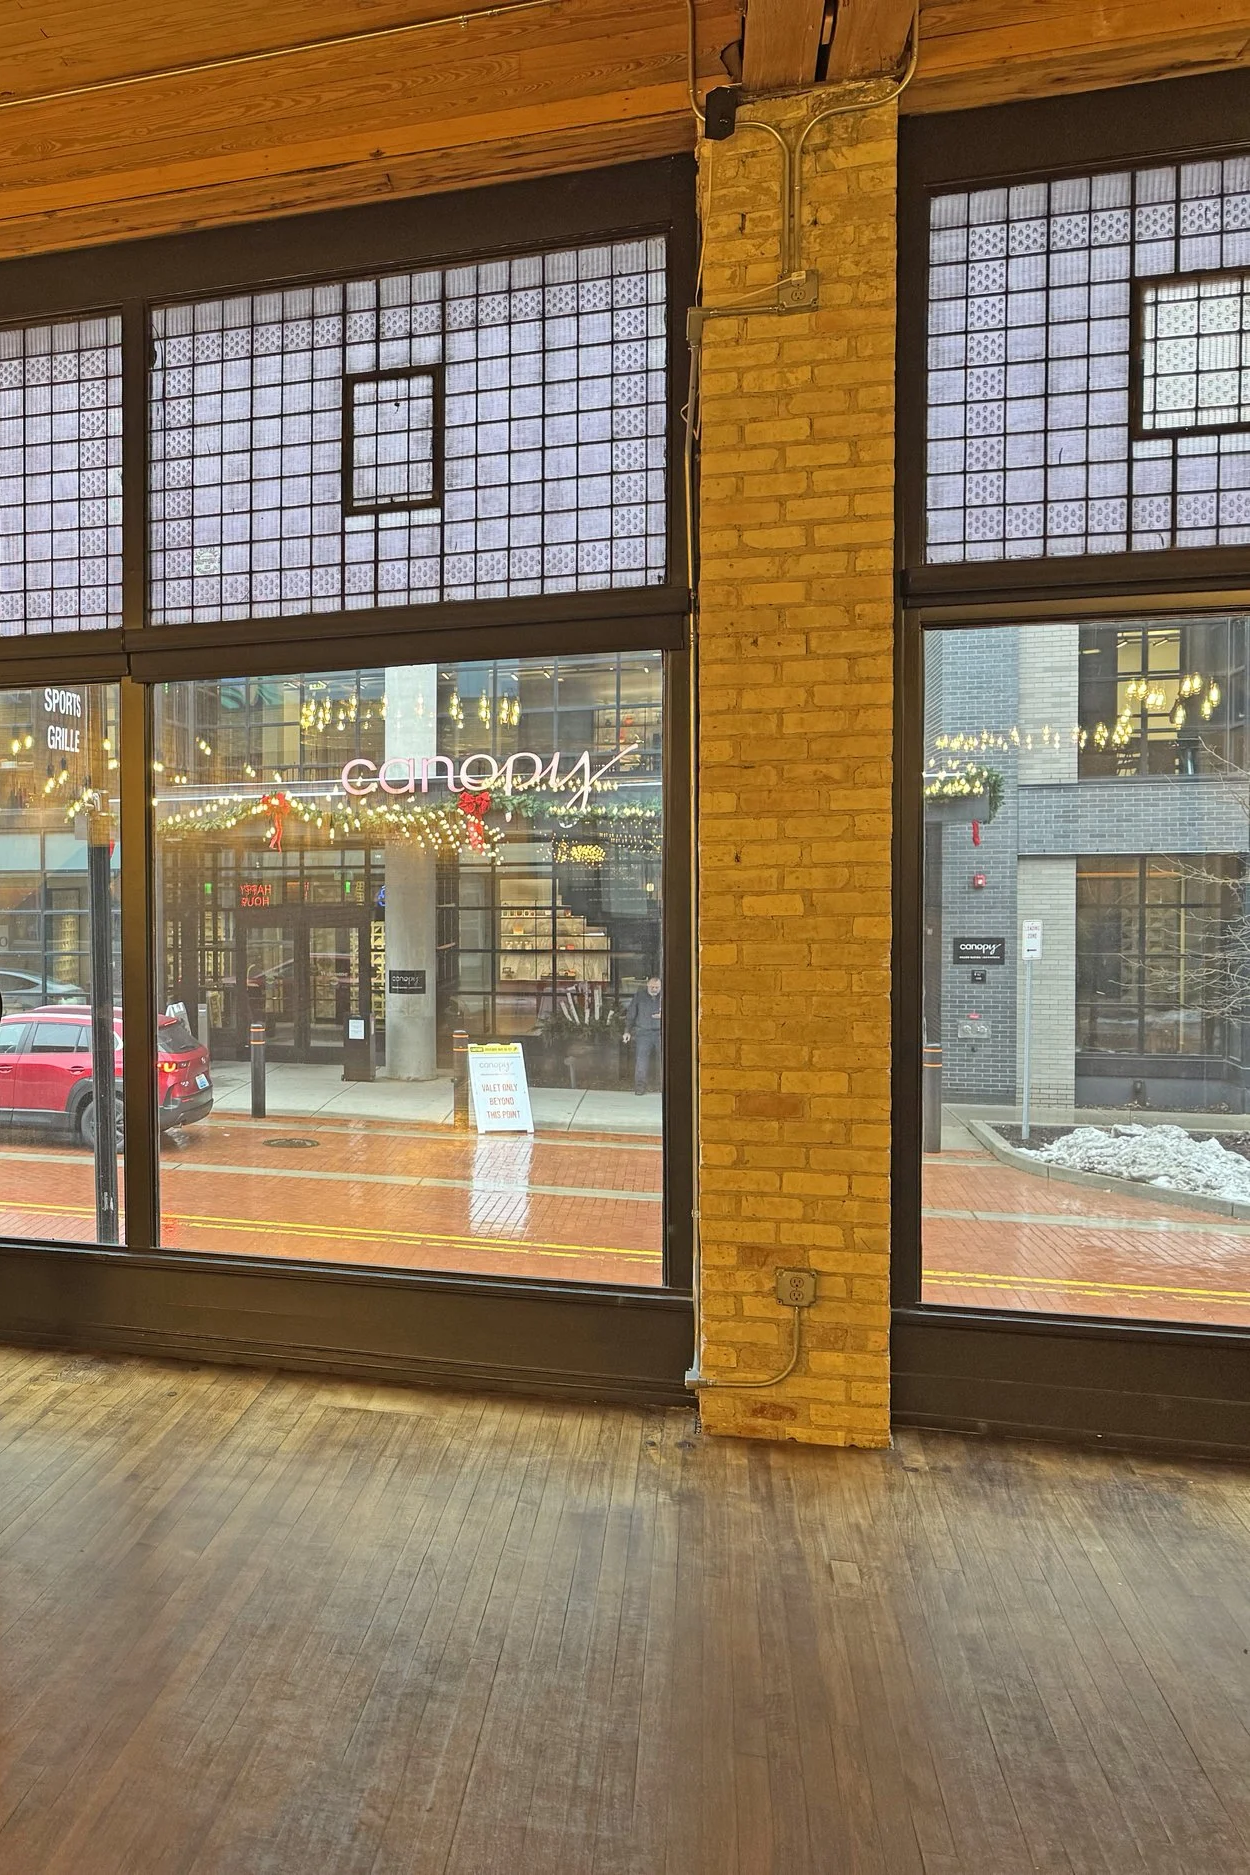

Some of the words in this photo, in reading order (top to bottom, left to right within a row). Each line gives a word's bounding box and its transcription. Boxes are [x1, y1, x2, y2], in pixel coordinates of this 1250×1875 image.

[44, 688, 82, 718] SPORTS
[47, 725, 80, 753] GRILLE
[341, 744, 638, 821] canopy
[959, 943, 1003, 955] canopy
[392, 975, 422, 986] canopy
[479, 1061, 514, 1073] canopy
[481, 1083, 501, 1093] VALET
[502, 1083, 519, 1092] ONLY
[489, 1096, 515, 1106] BEYOND
[486, 1110, 501, 1119] THIS
[502, 1110, 521, 1119] POINT
